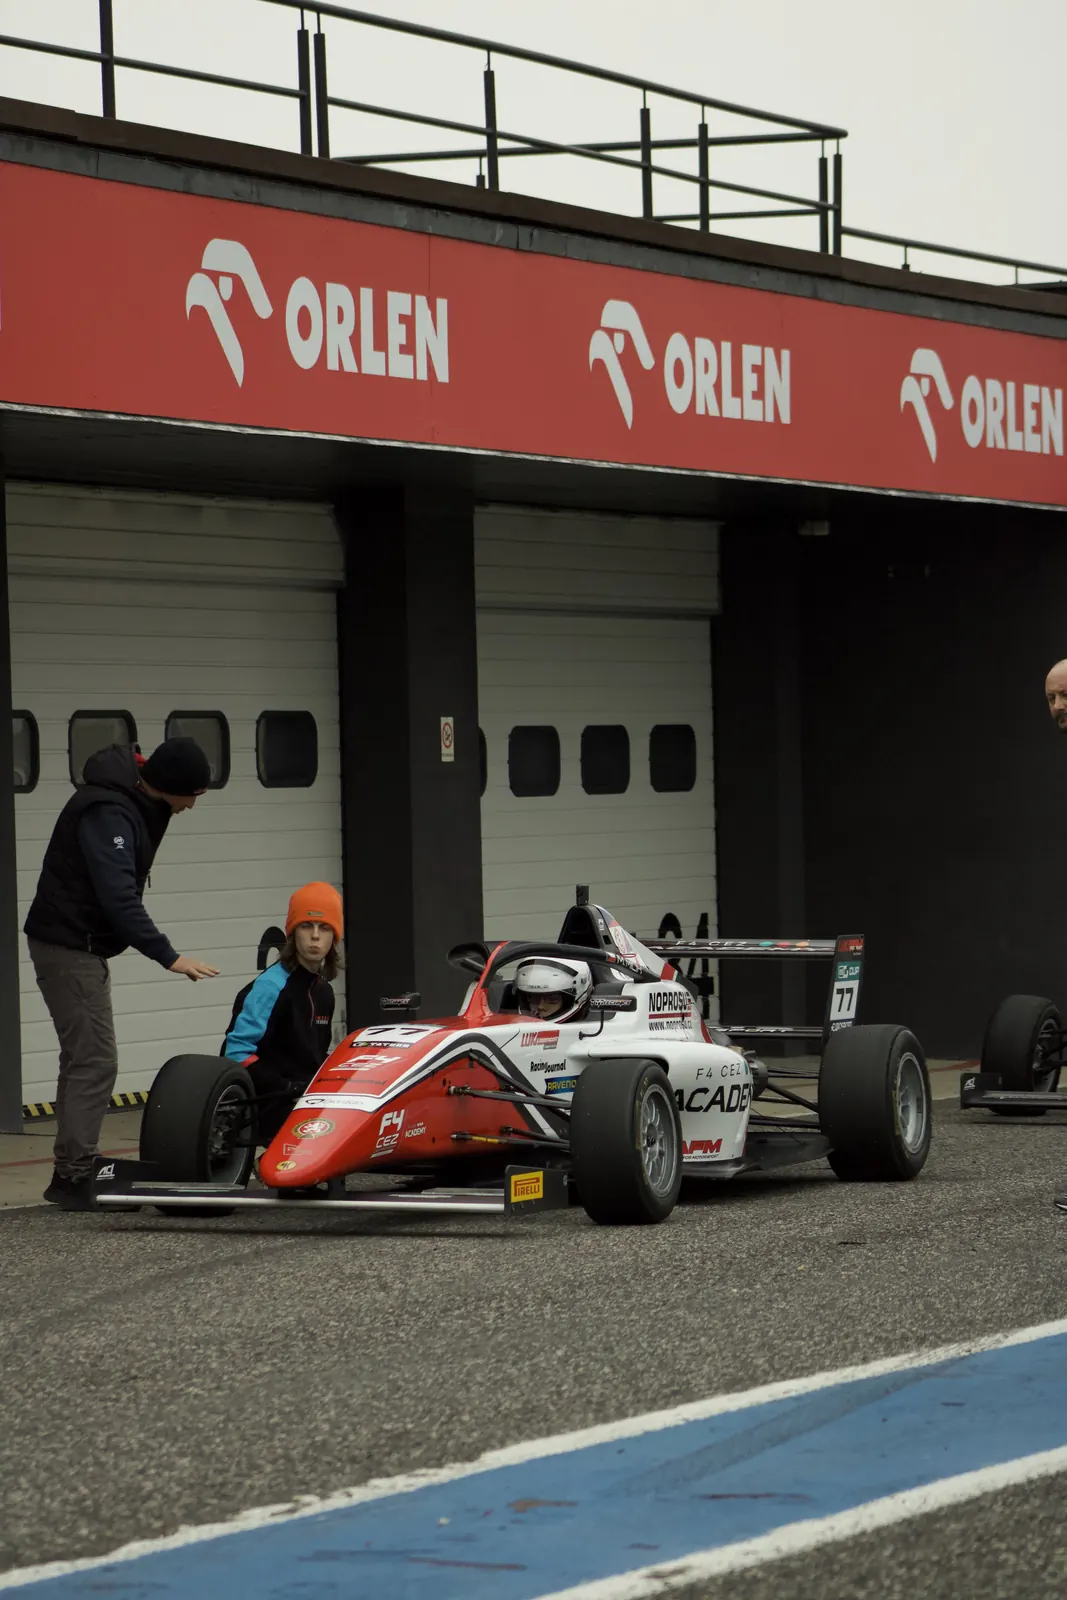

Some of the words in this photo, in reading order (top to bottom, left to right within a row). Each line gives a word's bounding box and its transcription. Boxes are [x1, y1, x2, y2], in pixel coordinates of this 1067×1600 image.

[285, 276, 449, 383] ORLEN
[664, 332, 791, 424] ORLEN
[960, 375, 1064, 456] ORLEN
[836, 987, 854, 1012] 77
[367, 1027, 430, 1036] 77
[696, 1068, 713, 1080] F4
[721, 1063, 741, 1077] CEZ
[547, 1080, 577, 1090] RAVENO
[675, 1083, 753, 1112] ACADE
[379, 1109, 405, 1136] F4
[405, 1126, 426, 1138] ACADEMY
[376, 1133, 399, 1148] CEZ
[514, 1177, 540, 1197] PIRELLI
